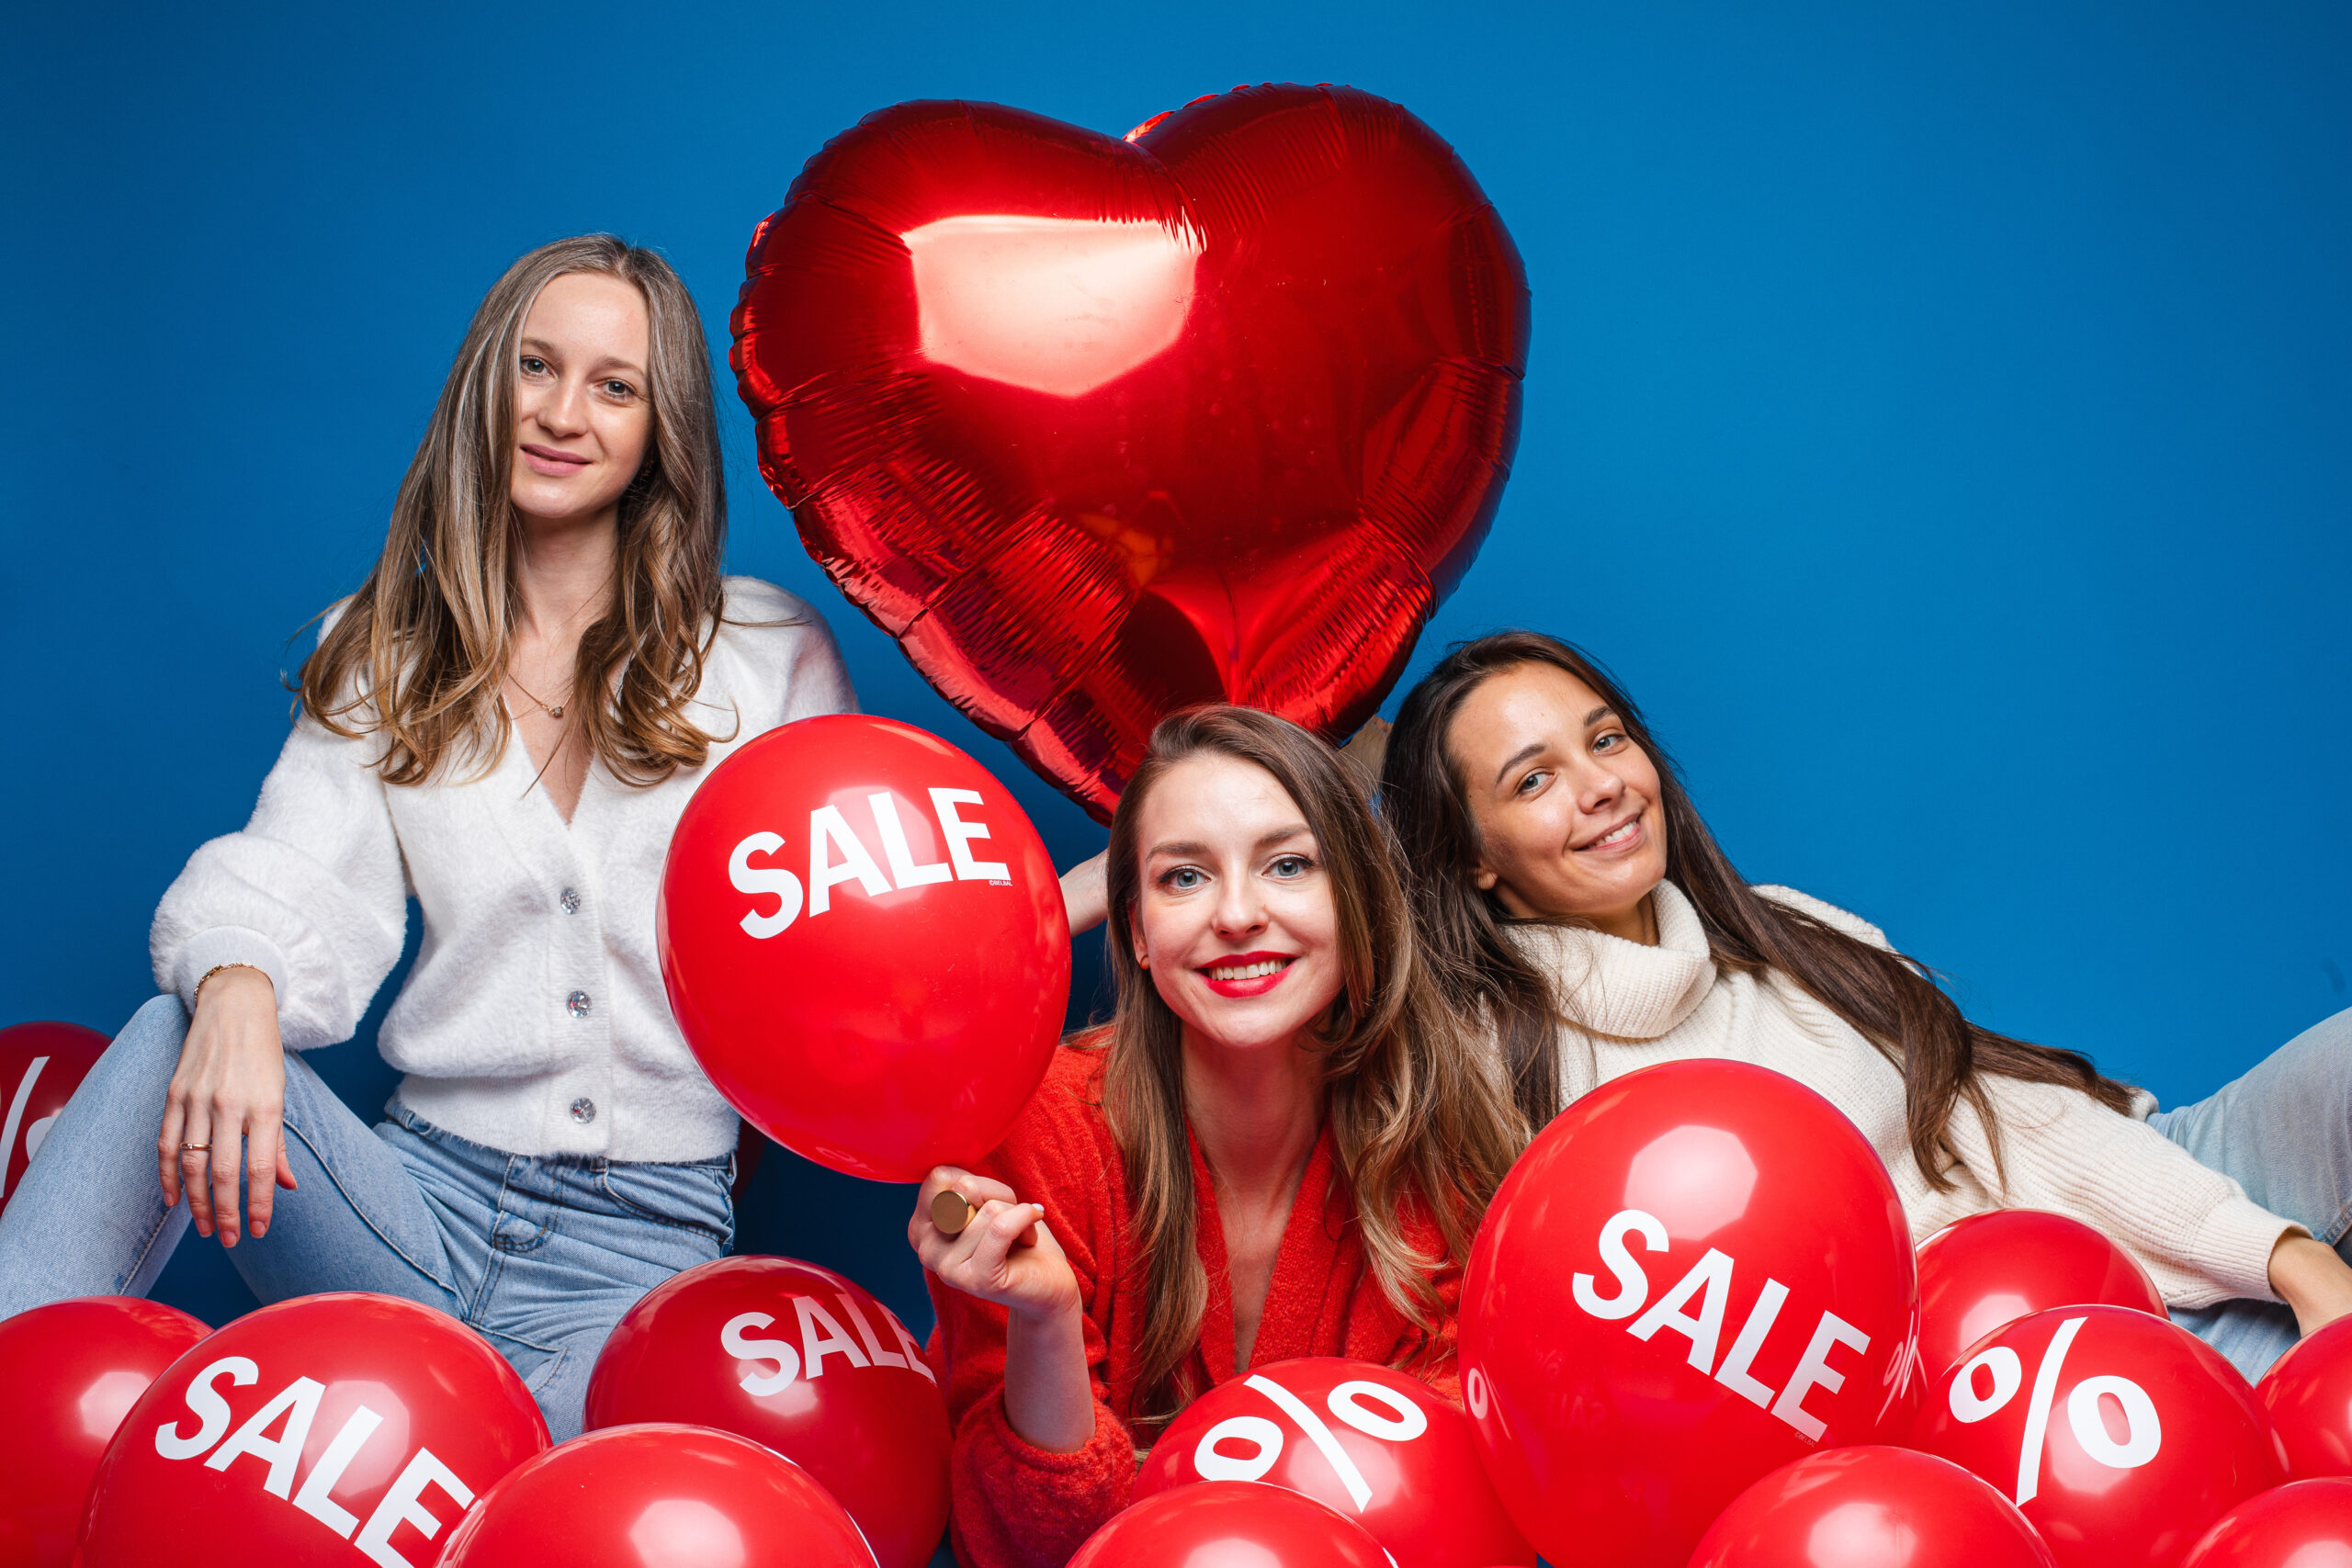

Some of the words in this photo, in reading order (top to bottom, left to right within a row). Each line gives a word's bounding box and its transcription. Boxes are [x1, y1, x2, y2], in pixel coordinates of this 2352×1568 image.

[729, 787, 1012, 939] SALE
[721, 1293, 937, 1397] SALE
[1572, 1209, 1871, 1443] SALE
[1949, 1316, 2162, 1508] %
[154, 1356, 476, 1568] SALE
[1194, 1374, 1428, 1514] %
